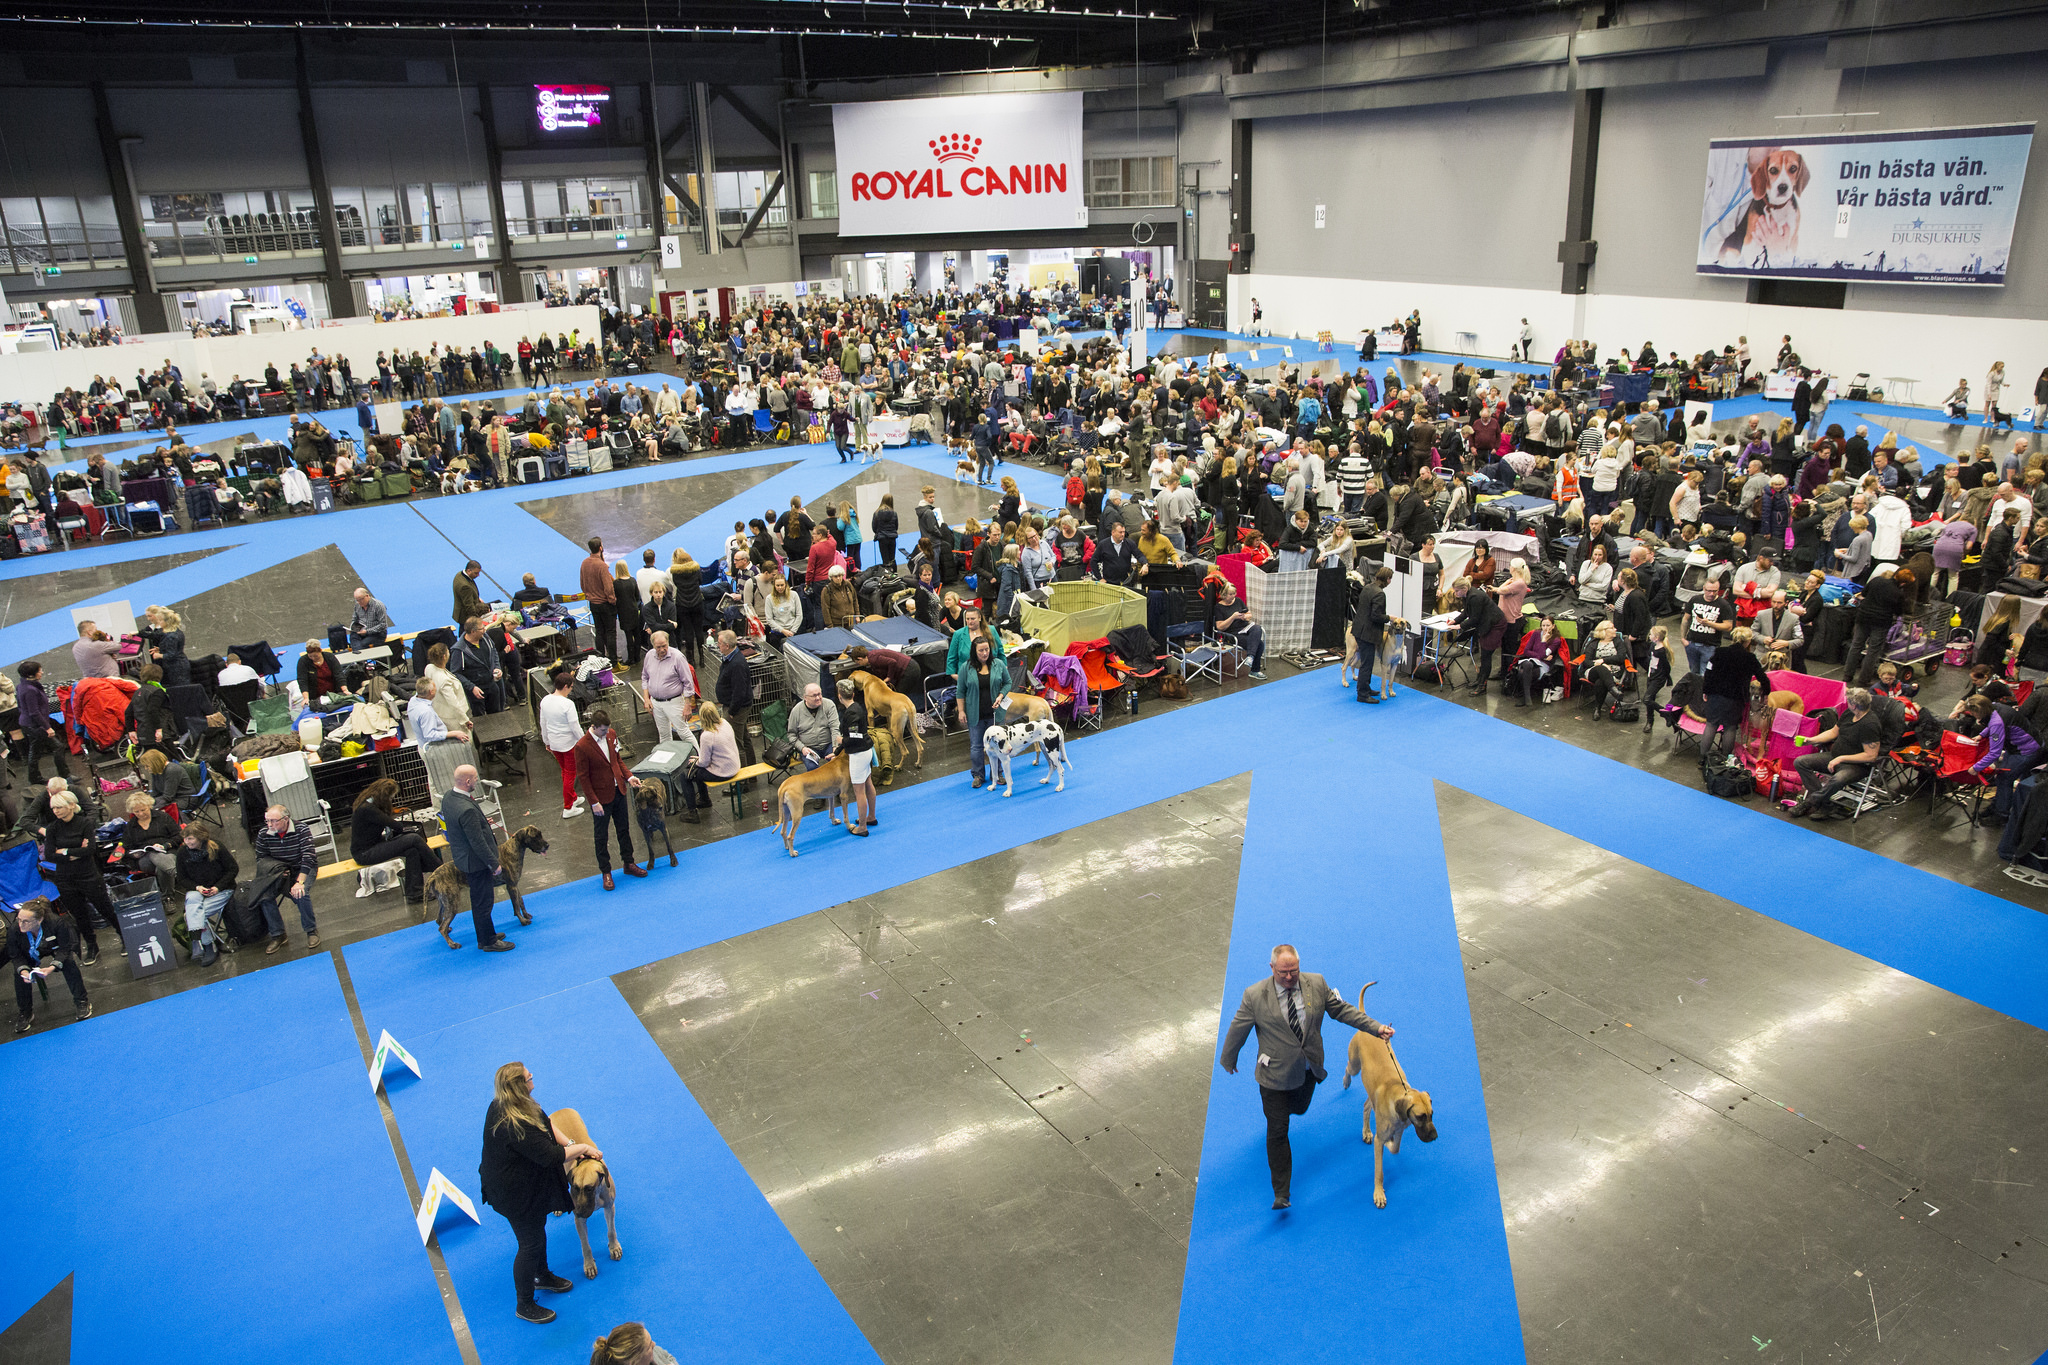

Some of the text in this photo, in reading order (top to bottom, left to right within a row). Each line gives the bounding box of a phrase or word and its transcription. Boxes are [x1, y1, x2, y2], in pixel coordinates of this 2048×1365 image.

[1840, 156, 1987, 179] Din bästa vän.
[852, 163, 1067, 201] ROYAL CANIN
[1837, 187, 1868, 206] Vår
[1875, 188, 1931, 206] bästa
[1315, 209, 1325, 221] 12
[1838, 212, 1848, 224] 13
[1892, 232, 1981, 245] DJURSJUKHUS
[479, 241, 484, 249] 6
[667, 243, 674, 254] 8
[34, 267, 41, 279] 5
[1914, 275, 1976, 283] www.blastjarnan.se
[1133, 298, 1145, 333] 10
[2022, 407, 2032, 416] 2
[1693, 602, 1720, 614] YOU'LL
